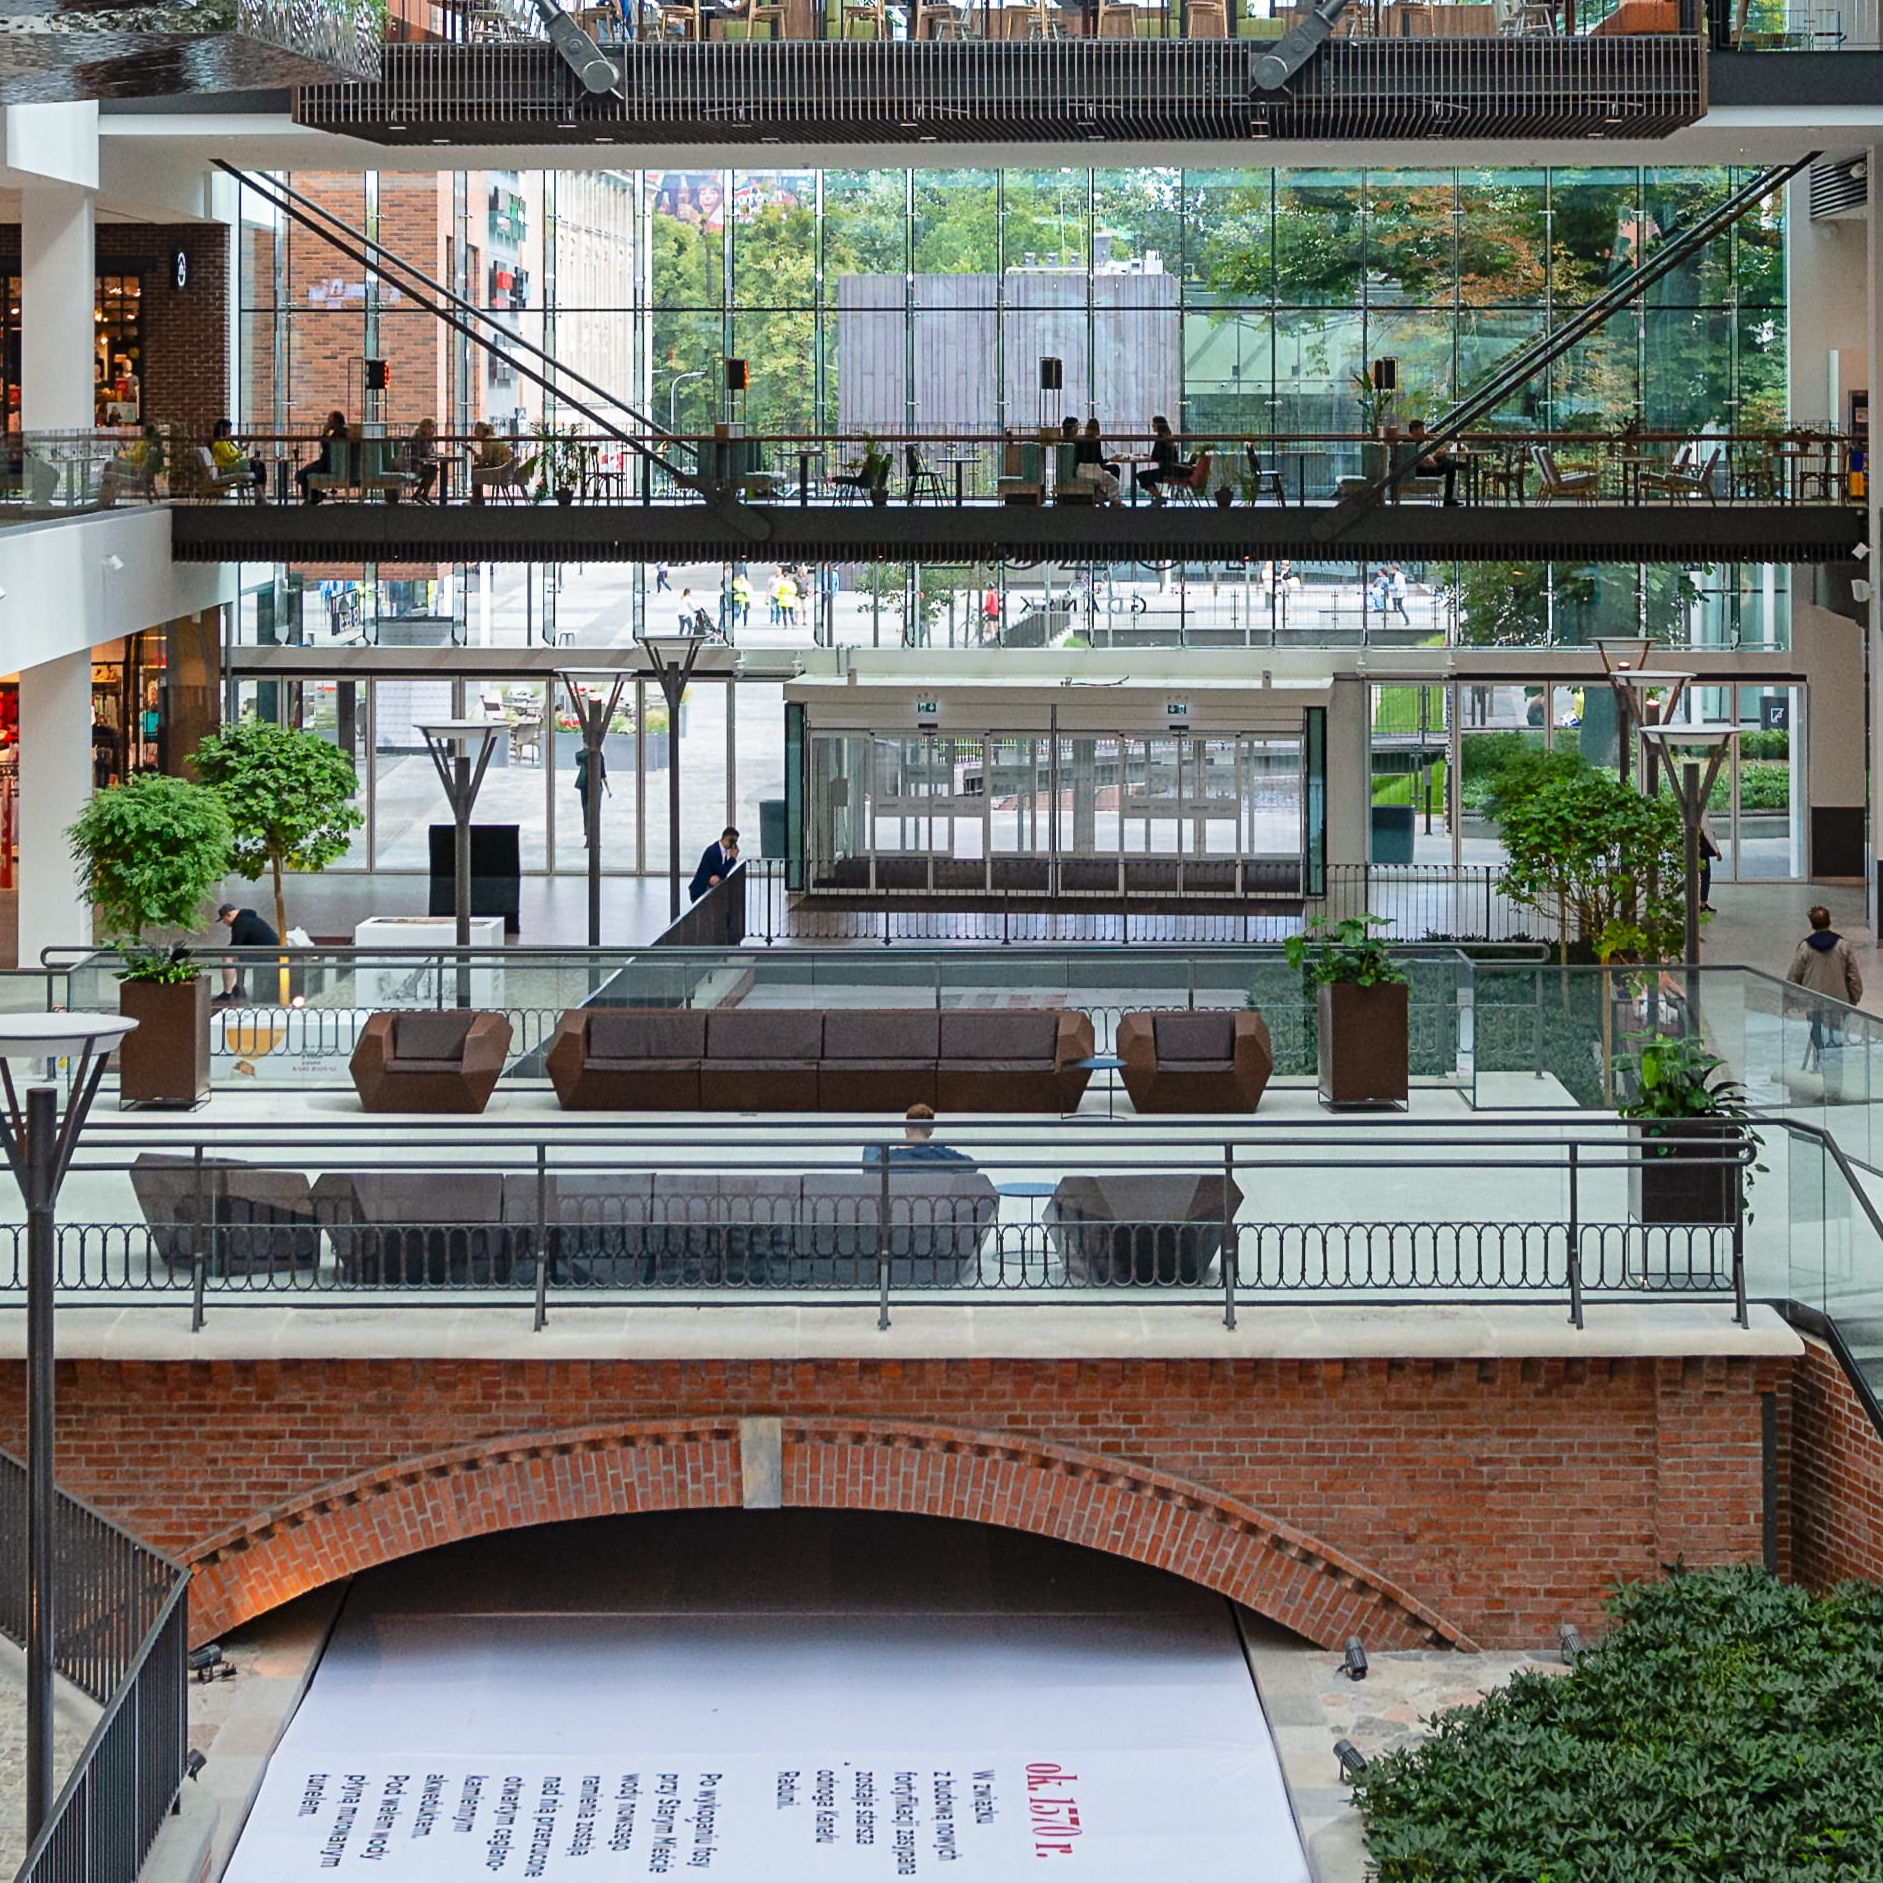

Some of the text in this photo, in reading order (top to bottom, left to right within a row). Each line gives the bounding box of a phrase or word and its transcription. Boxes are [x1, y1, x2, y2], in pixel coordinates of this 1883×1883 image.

[298, 1774, 330, 1817] tunelem.
[383, 1775, 409, 1795] Pod
[411, 1774, 447, 1839] akweduktem.
[453, 1775, 490, 1833] kamiennym
[494, 1776, 525, 1825] otwartym
[566, 1776, 603, 1856] ramienia zostają
[609, 1774, 642, 1851] wody nowszego
[776, 1772, 801, 1809] Raduni.
[811, 1770, 840, 1843] odnoga Kanału
[850, 1772, 880, 1844] zostaje starsza
[929, 1780, 960, 1820] budową
[970, 1770, 997, 1824] W związku
[1026, 1763, 1083, 1858] ok. 1570 r.
[320, 1807, 360, 1868] murowanym
[360, 1832, 392, 1860] wody
[524, 1776, 564, 1877] nad nią przerzucone
[648, 1774, 681, 1873] przy Starym Mieście
[687, 1774, 722, 1868] Po wykopaniu fosy
[891, 1772, 919, 1875] fortyfikacji zasypana
[934, 1823, 962, 1861] nowych
